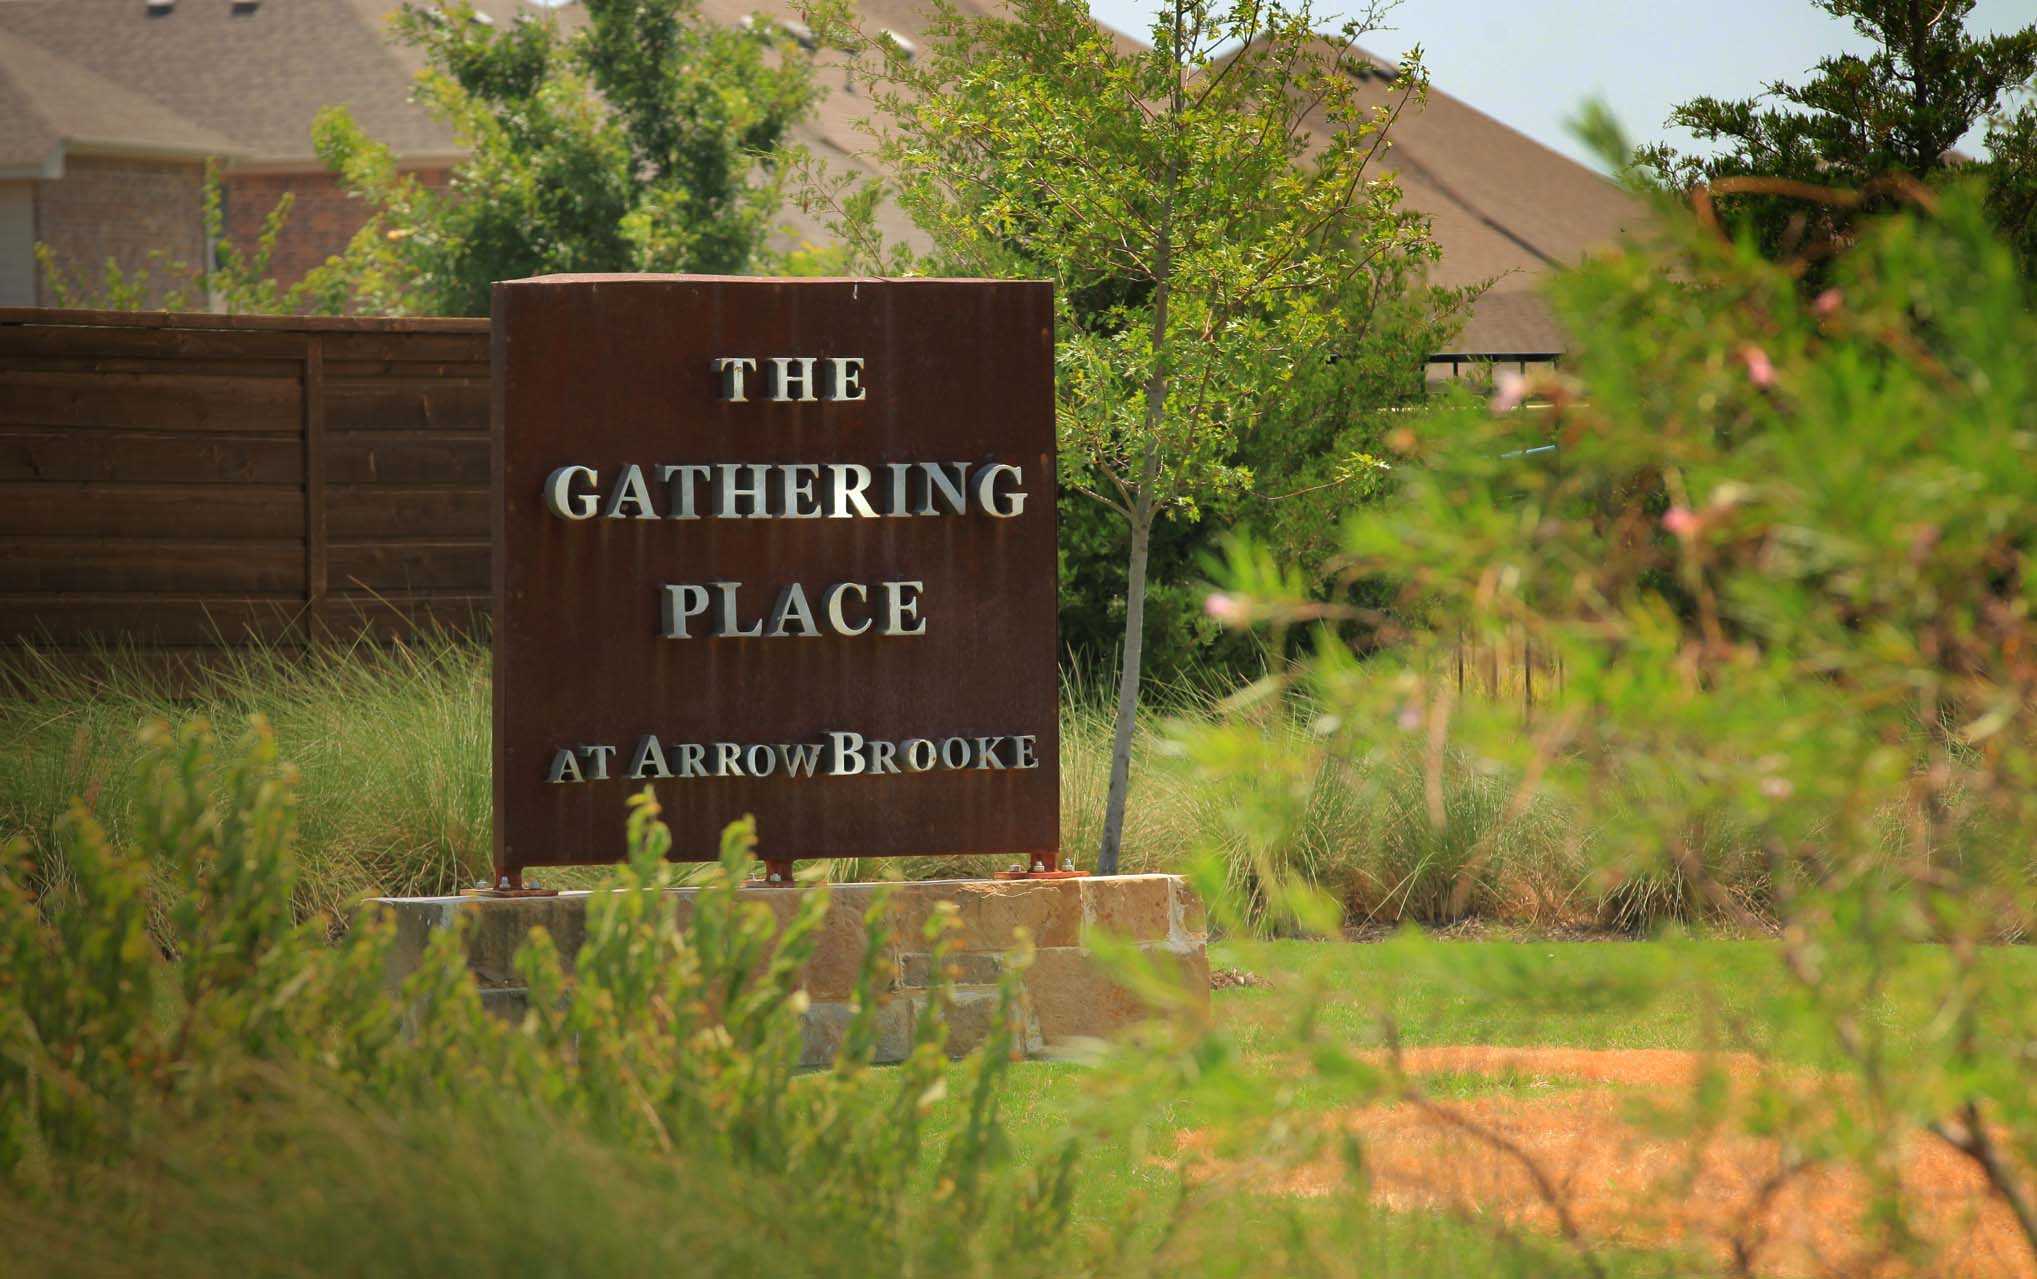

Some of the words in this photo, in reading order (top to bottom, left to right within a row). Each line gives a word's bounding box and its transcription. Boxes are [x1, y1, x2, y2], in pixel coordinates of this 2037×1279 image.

[717, 356, 867, 402] THE
[545, 461, 1029, 520] GATHERING
[662, 580, 927, 639] PLACE
[549, 745, 617, 784] AT
